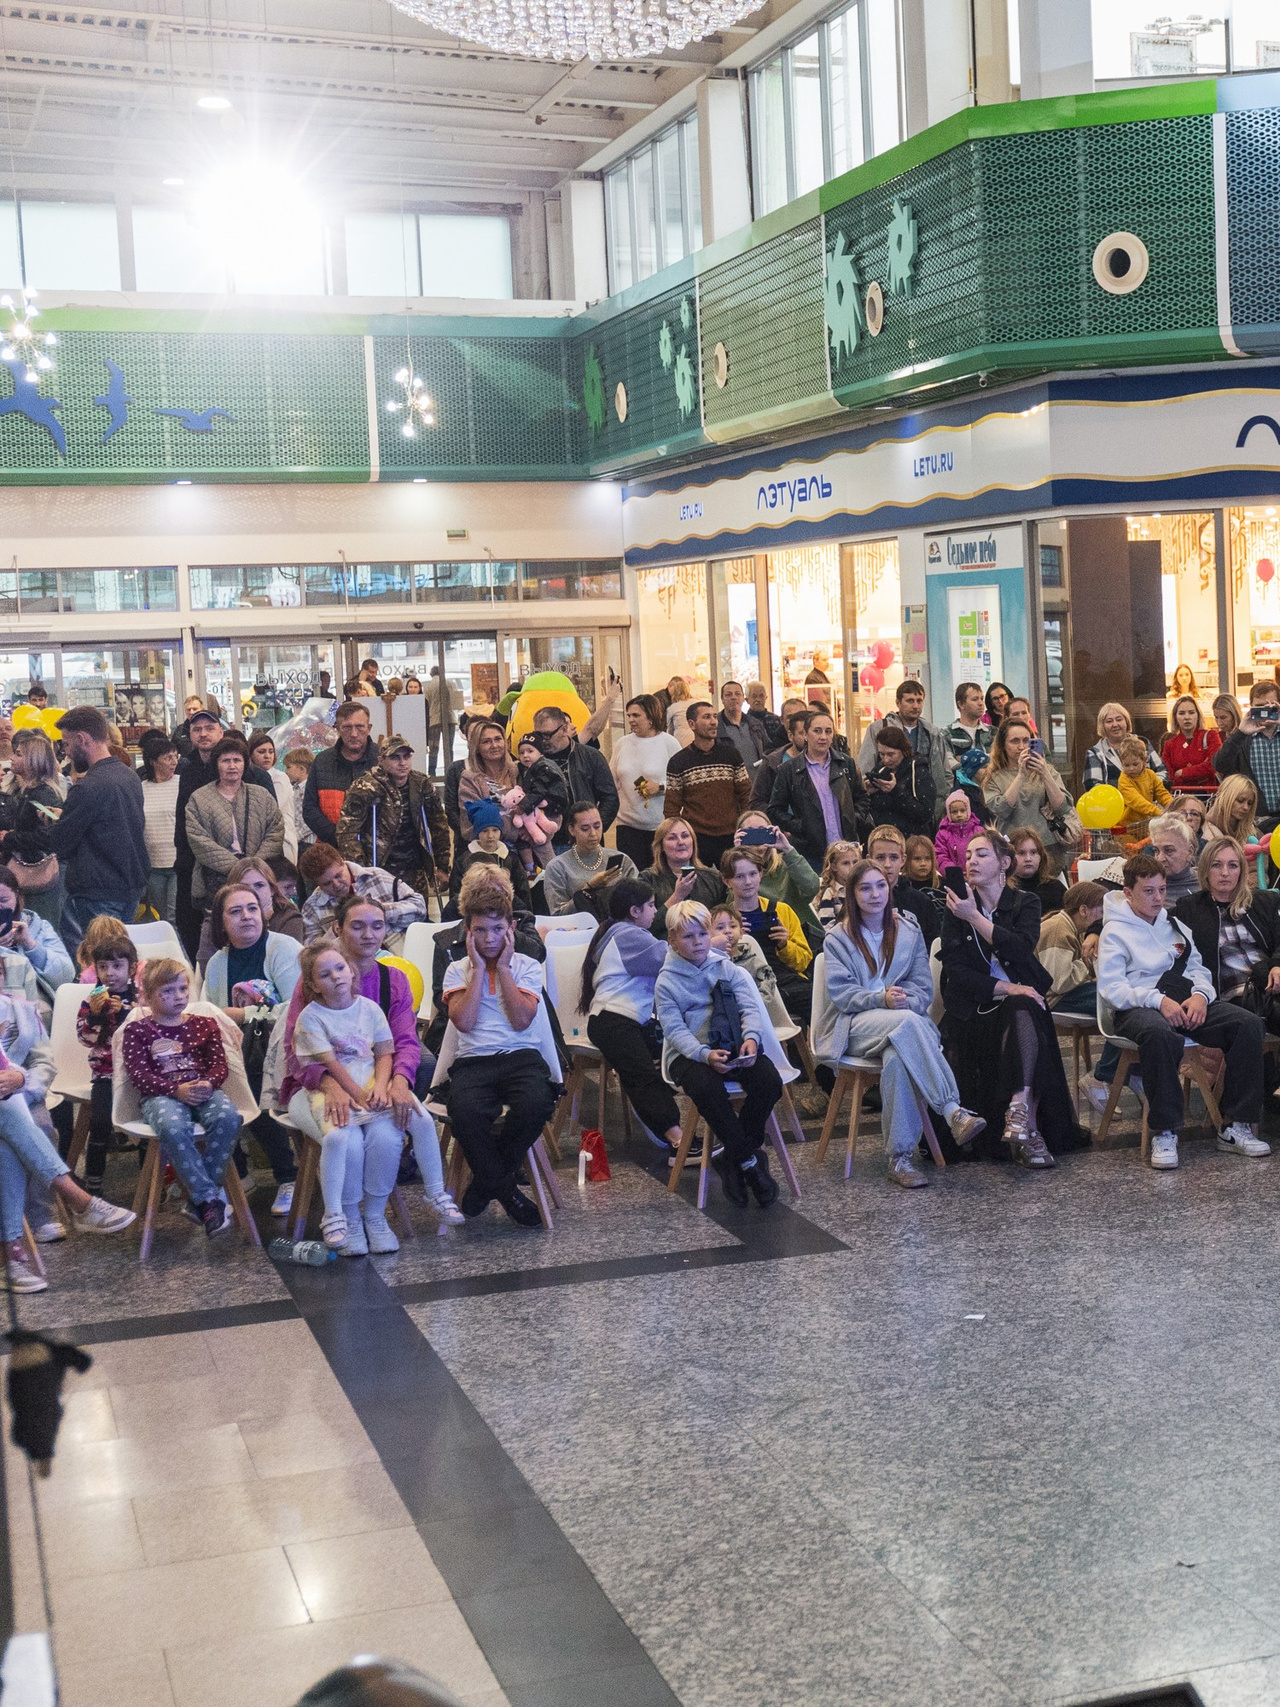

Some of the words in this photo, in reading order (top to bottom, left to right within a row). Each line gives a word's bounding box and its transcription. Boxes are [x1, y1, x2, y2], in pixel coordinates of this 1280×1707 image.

[913, 452, 954, 477] LETU.RU
[679, 502, 704, 521] LETU.RU
[255, 671, 322, 687] ВЫХОД
